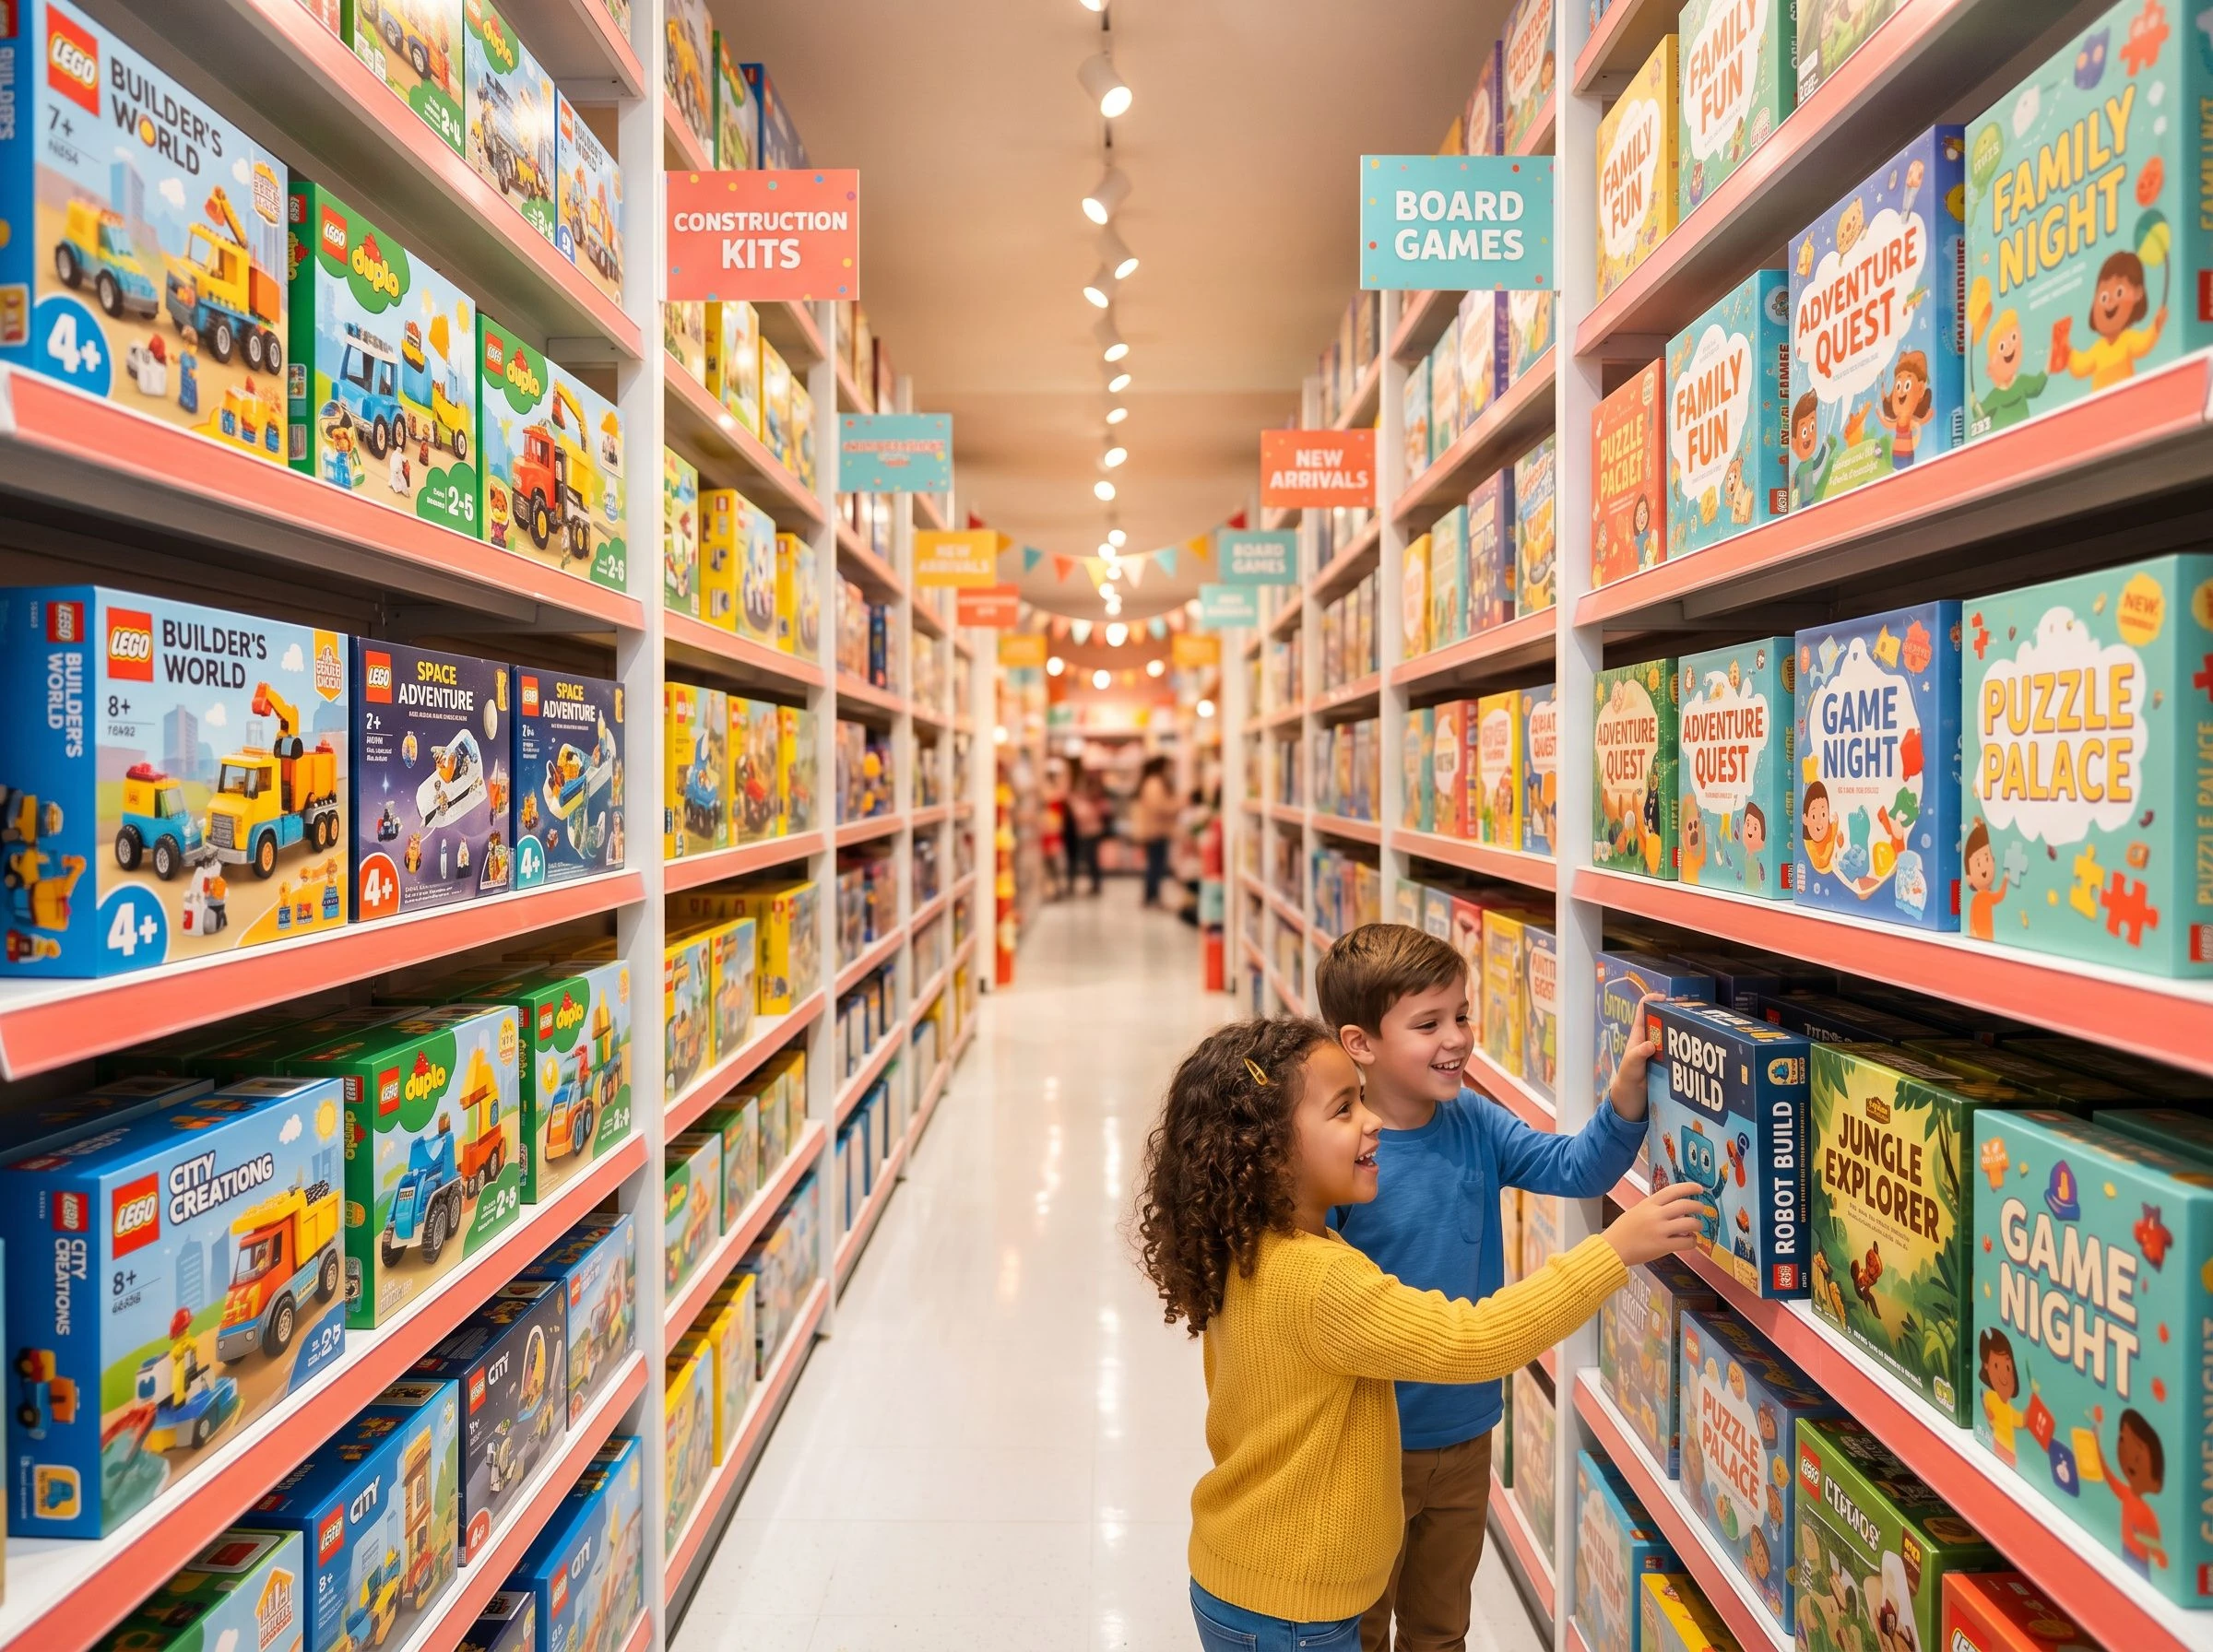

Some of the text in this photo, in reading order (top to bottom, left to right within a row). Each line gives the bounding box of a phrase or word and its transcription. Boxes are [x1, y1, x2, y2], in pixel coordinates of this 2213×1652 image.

[52, 37, 96, 85] LEGO
[110, 55, 223, 158] BUILDER'S
[1701, 49, 1744, 136] FUN
[48, 103, 74, 137] 7+
[111, 94, 201, 176] WORLD
[1604, 114, 1652, 204] FAMILY
[1993, 83, 2136, 234] FAMILY
[674, 211, 847, 232] CONSTRUCTION
[1395, 190, 1524, 221] BOARD
[1612, 171, 1643, 240] FUN
[1394, 229, 1524, 261] GAMES
[1998, 163, 2127, 298] NIGHT
[351, 245, 399, 298] duplo
[722, 239, 801, 269] KITS
[1797, 226, 1918, 339] ADVENTURE
[47, 313, 101, 373] 4+
[1816, 289, 1895, 379] QUEST
[506, 360, 540, 398] duplo
[1676, 348, 1744, 431] FAMILY
[1296, 449, 1343, 468] NEW
[1601, 413, 1643, 471] PUZZLE
[1686, 410, 1728, 474] FUN
[1270, 470, 1368, 489] ARRIVALS
[448, 486, 474, 522] 2-5
[1232, 543, 1285, 558] BOARD
[1232, 559, 1286, 574] GAMES
[110, 629, 150, 660] LEGO
[162, 619, 267, 661] BUILDER'S
[47, 653, 64, 729] WORLD
[163, 654, 246, 689] WORLD
[368, 666, 390, 689] LEGO
[417, 660, 457, 685] SPACE
[556, 682, 584, 702] SPACE
[65, 652, 83, 759] BUILDER'S
[108, 695, 131, 717] 8+
[398, 683, 474, 712] ADVENTURE
[542, 700, 596, 722] ADVENTURE
[1823, 687, 1898, 735] GAME
[1983, 663, 2135, 736] PUZZLE
[366, 713, 381, 730] 2+
[1597, 717, 1655, 746] ADVENTURE
[1684, 707, 1763, 741] ADVENTURE
[1605, 749, 1645, 785] QUEST
[1695, 745, 1749, 786] QUEST
[1823, 735, 1899, 779] NIGHT
[1983, 738, 2134, 803] PALACE
[520, 847, 541, 879] 4+
[364, 867, 393, 907] 4+
[107, 902, 159, 957] 4+
[1667, 1027, 1727, 1080] ROBOT
[406, 1063, 446, 1101] duplo
[1672, 1064, 1723, 1113] BUILD
[1838, 1112, 1923, 1187] JUNGLE
[169, 1150, 216, 1195] CITY
[1772, 1102, 1796, 1255] ROBOT BUILD
[115, 1195, 158, 1234] LEGO
[1826, 1147, 1940, 1244] EXPLORER
[71, 1238, 87, 1280] CITY
[2000, 1198, 2139, 1326] GAME
[54, 1237, 71, 1336] CREATIONS
[112, 1269, 137, 1296] 8+
[2000, 1275, 2140, 1399] NIGHT
[1703, 1389, 1758, 1472] PUZZLE
[1703, 1432, 1758, 1510] PALACE
[349, 1475, 381, 1525] CITY
